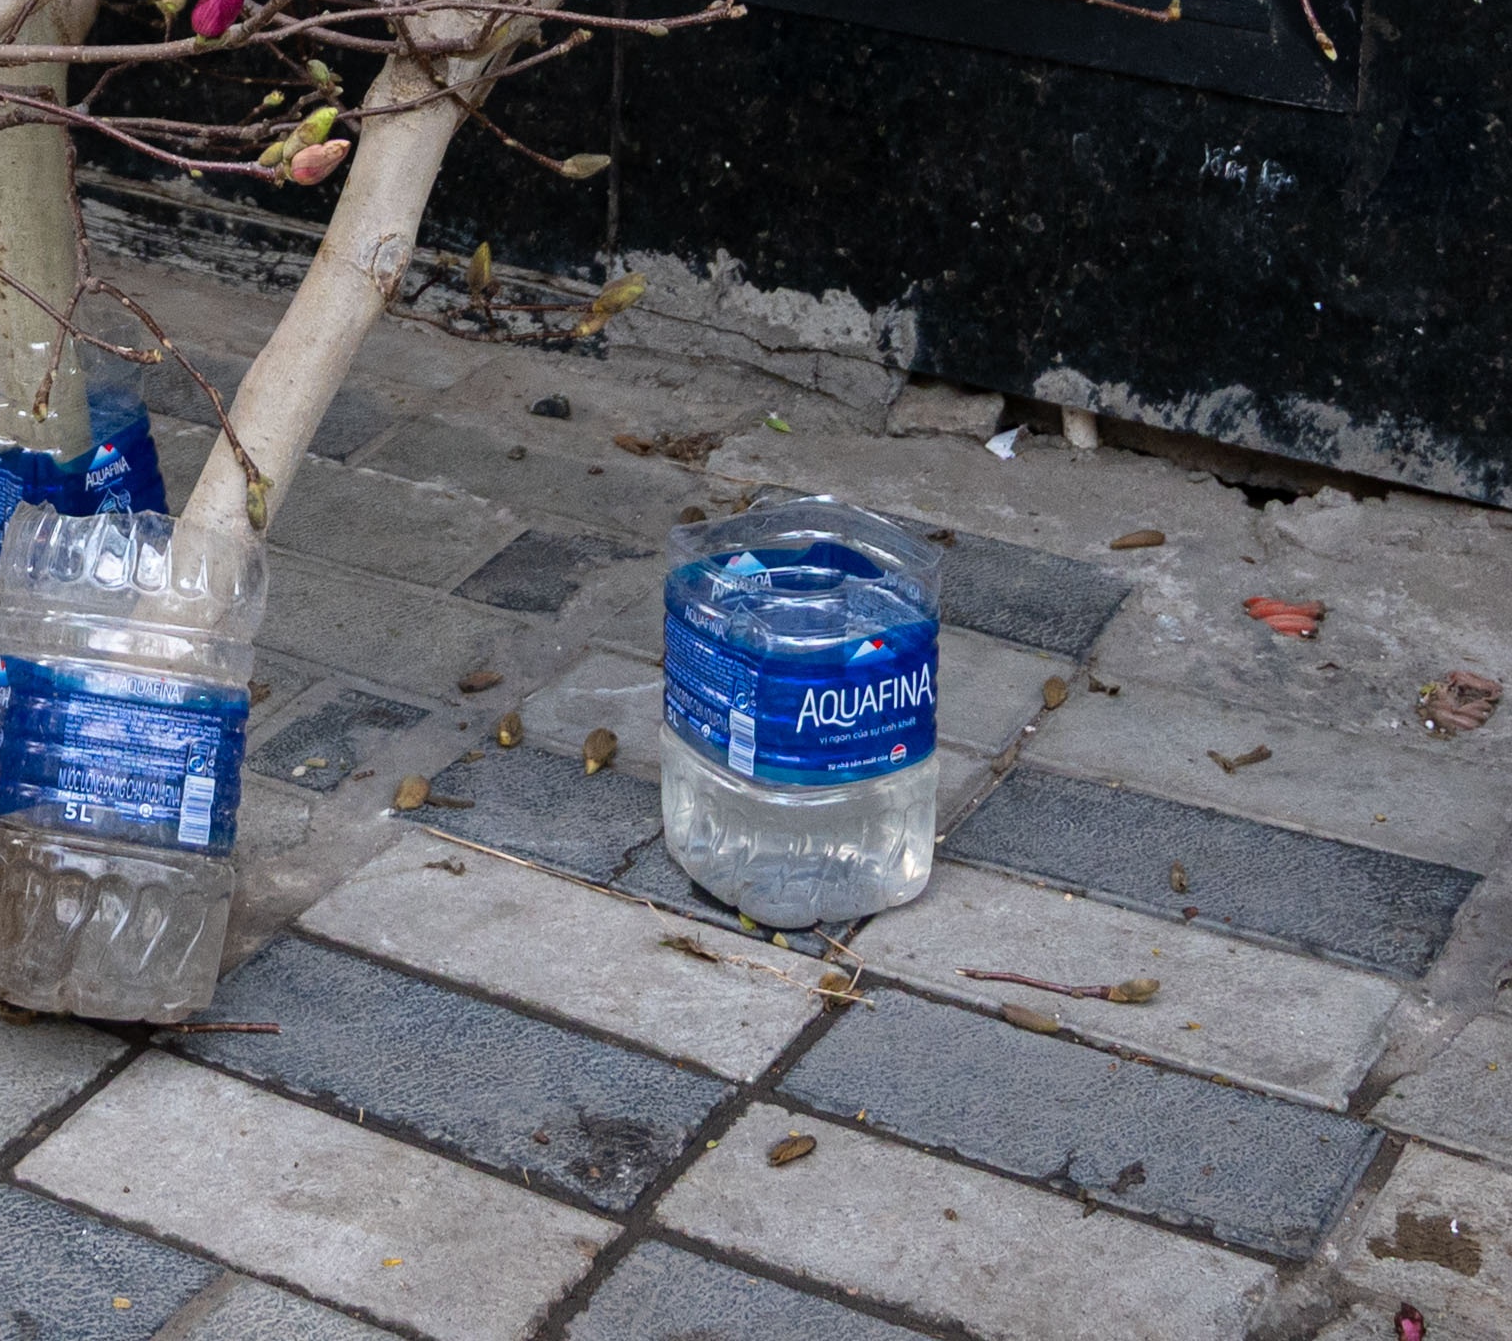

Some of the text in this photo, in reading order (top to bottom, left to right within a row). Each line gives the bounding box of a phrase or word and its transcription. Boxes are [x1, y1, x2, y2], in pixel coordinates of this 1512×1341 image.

[84, 455, 132, 492] AQUAFINA
[118, 676, 184, 704] AQUAFINA
[795, 661, 936, 734] AQUAFINA
[64, 801, 77, 820] 5
[79, 803, 92, 823] L
